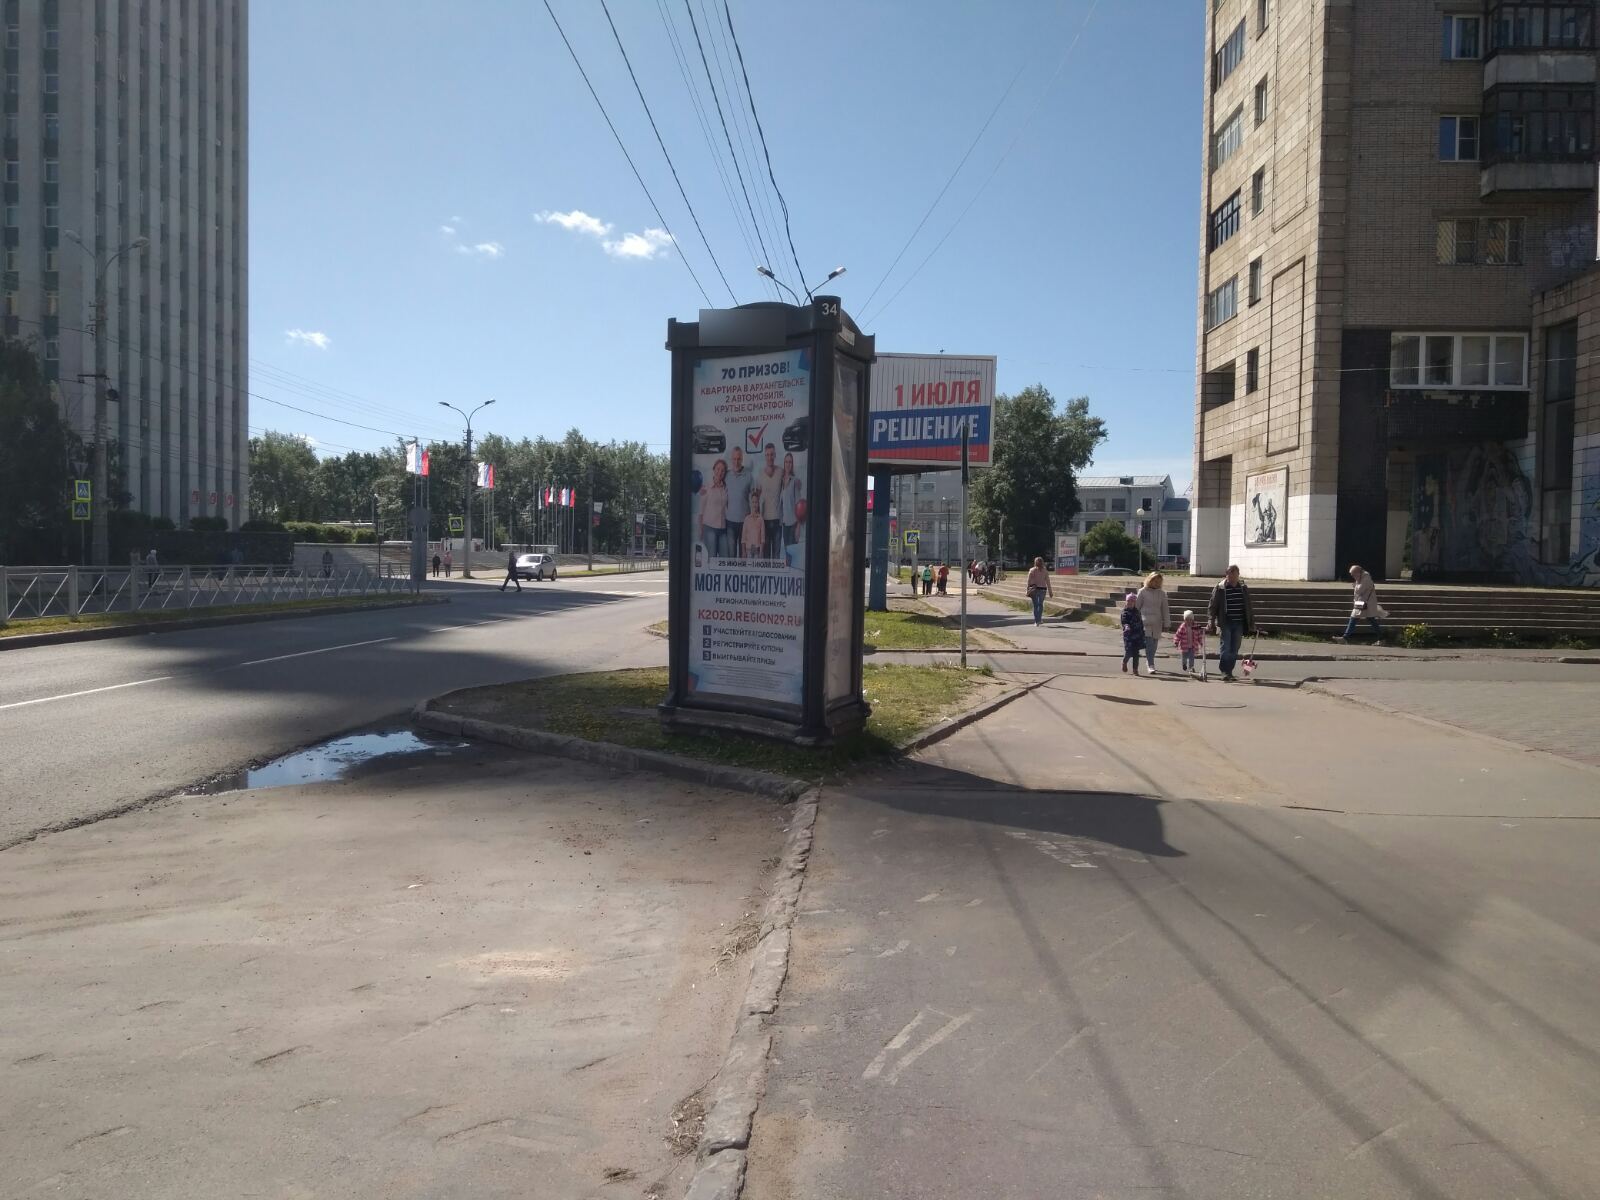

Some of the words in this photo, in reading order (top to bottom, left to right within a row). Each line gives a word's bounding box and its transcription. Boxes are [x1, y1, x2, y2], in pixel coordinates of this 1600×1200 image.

[821, 302, 838, 316] 34
[721, 368, 735, 379] 70
[739, 361, 790, 378] ПРИЗОВ!
[701, 385, 741, 395] КВАРТИРА
[744, 385, 749, 393] В
[895, 384, 903, 407] 1
[911, 379, 981, 407] ИЮЛЯ
[715, 404, 745, 414] КРУТЫЕ
[747, 400, 794, 412] СМАРТФОНЫ
[725, 395, 731, 404] 2
[872, 414, 980, 443] РЕШЕНИЕ
[695, 573, 721, 593] МОЯ
[698, 609, 801, 626] K2020.REGION29.RU
